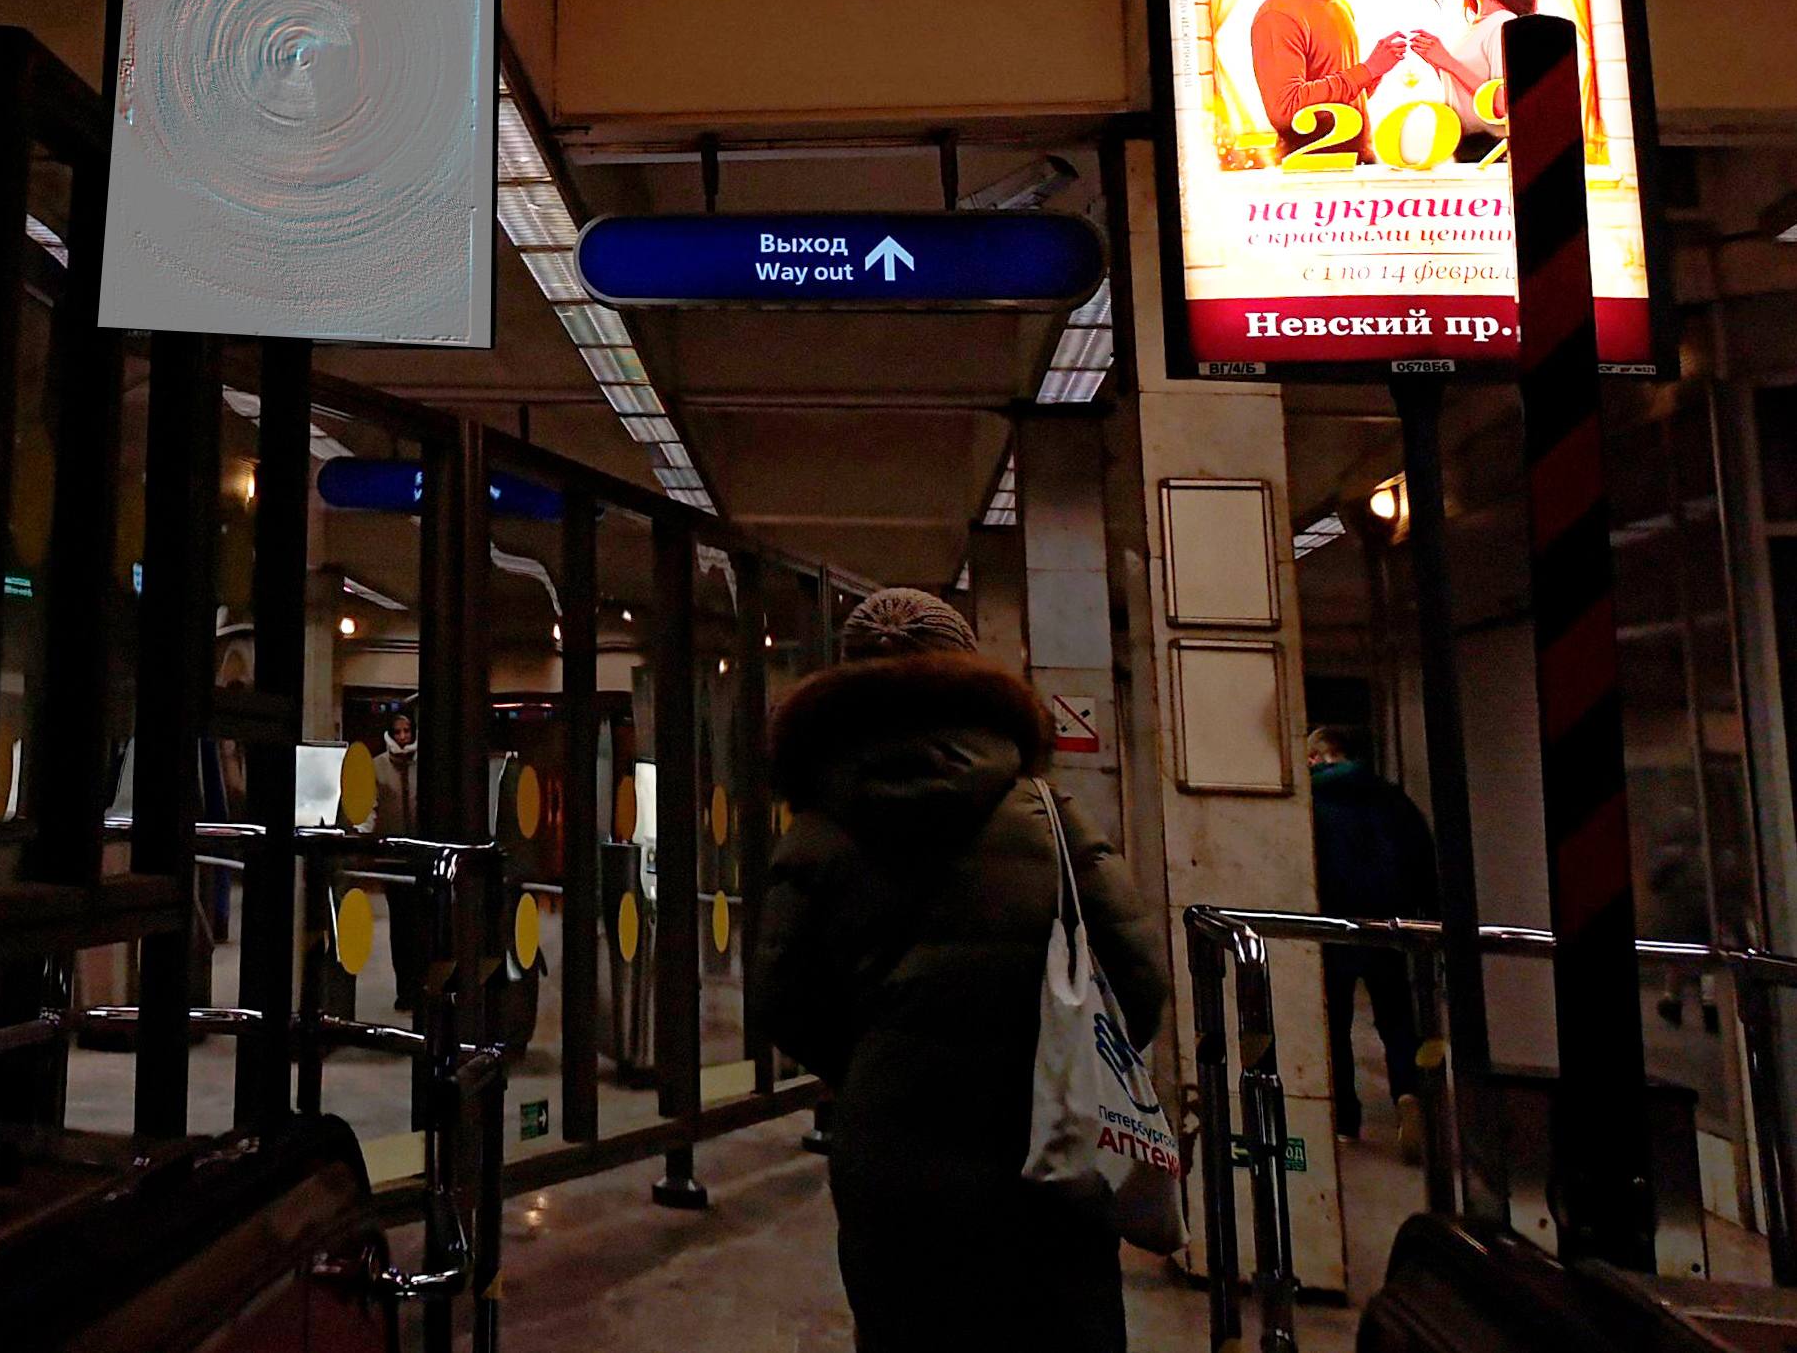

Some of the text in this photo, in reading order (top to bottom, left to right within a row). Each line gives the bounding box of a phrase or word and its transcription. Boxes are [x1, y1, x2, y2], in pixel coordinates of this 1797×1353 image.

[1248, 201, 1298, 222] на
[759, 233, 849, 256] Выход
[1247, 232, 1257, 245] с
[1268, 230, 1410, 248] красными
[755, 262, 854, 285] Way out
[1302, 259, 1516, 284] с 1 по 14 феврал
[1244, 309, 1513, 343] Невский пр.
